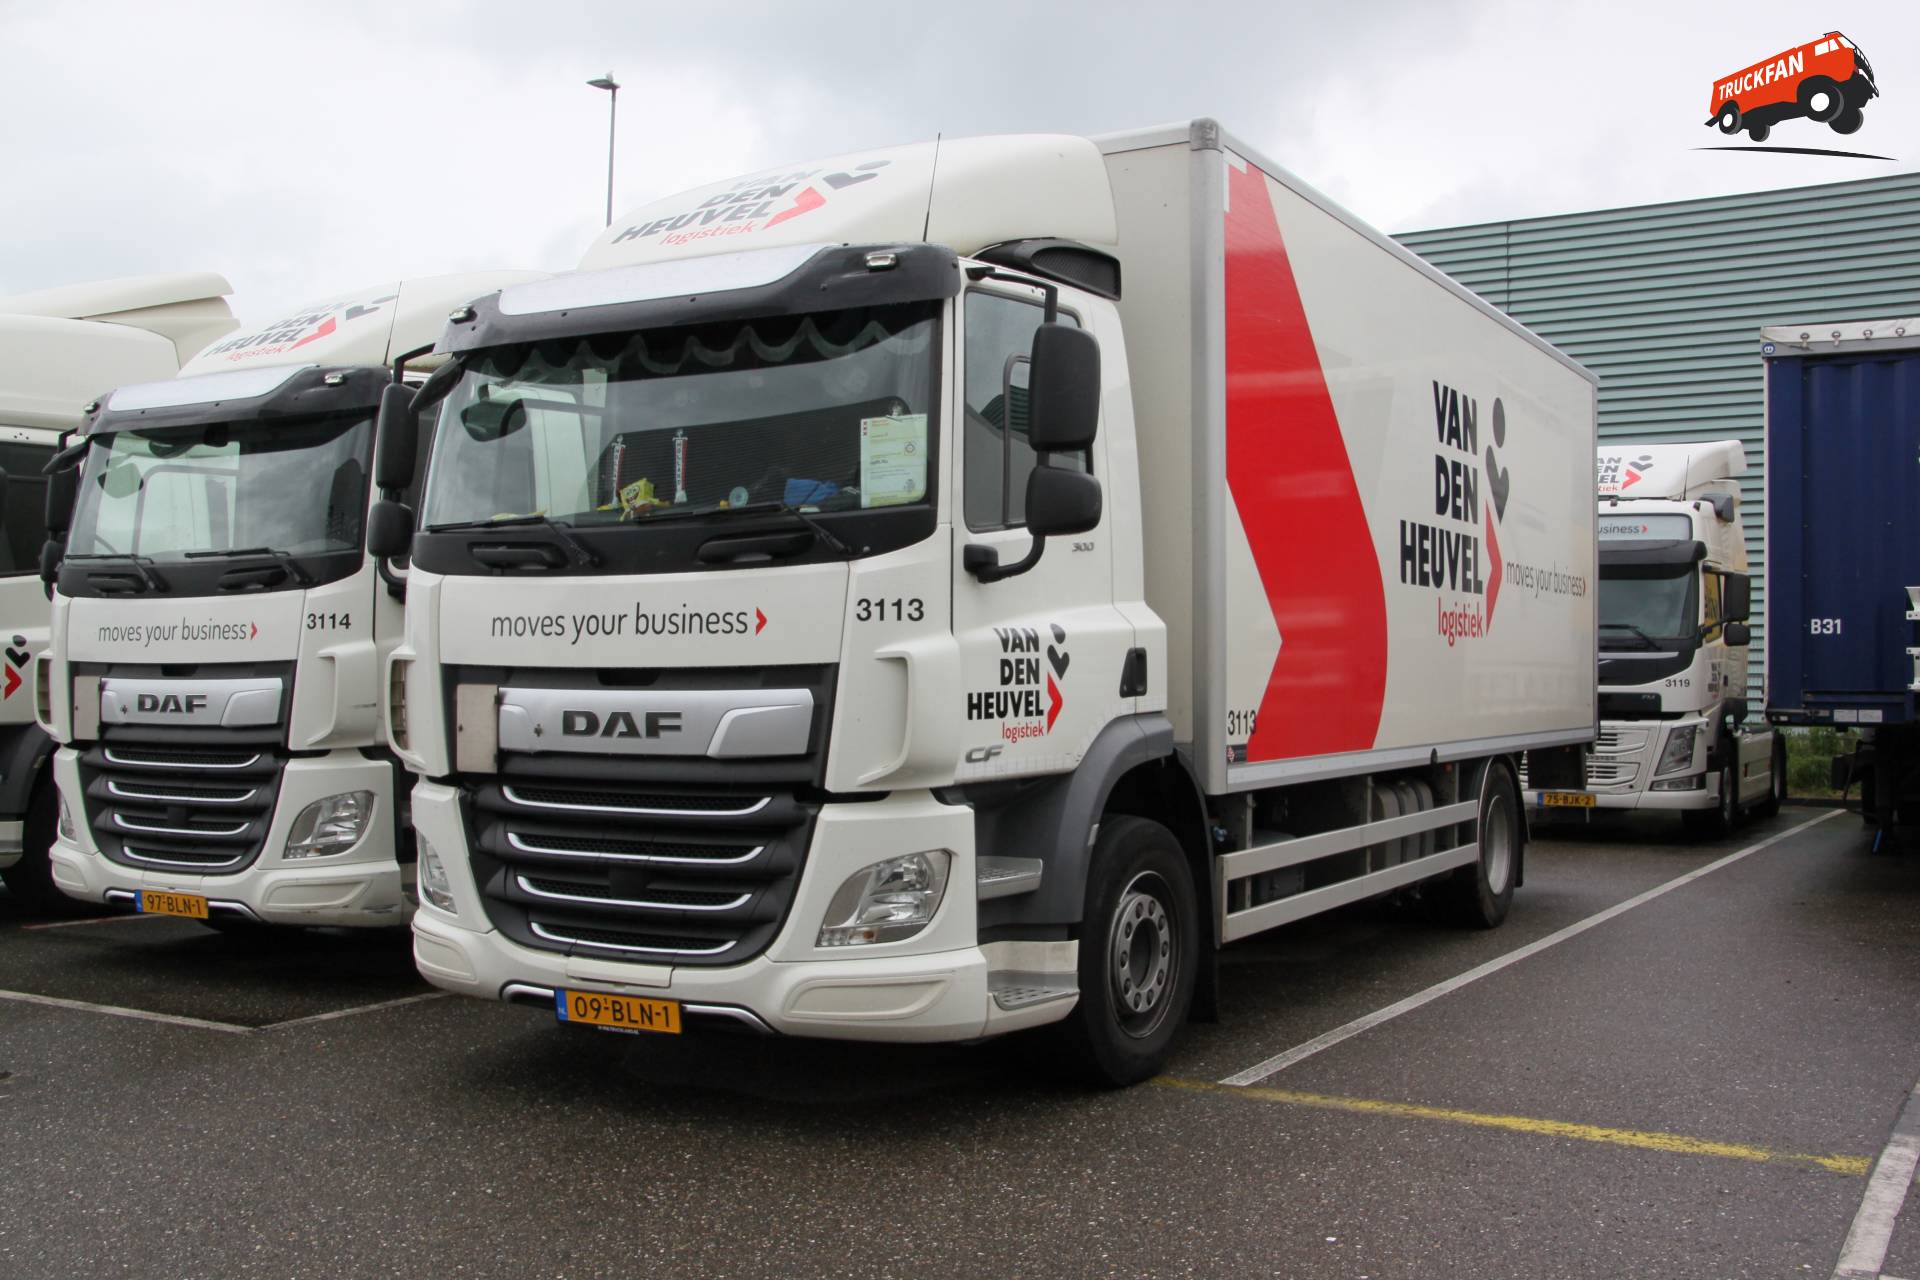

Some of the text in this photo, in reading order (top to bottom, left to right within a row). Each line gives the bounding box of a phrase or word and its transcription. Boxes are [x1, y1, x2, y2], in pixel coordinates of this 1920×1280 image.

[700, 182, 798, 209] DEN
[611, 200, 775, 245] HEUVEL
[659, 221, 757, 247] logistiek
[203, 327, 307, 358] HEUVEL
[1432, 380, 1478, 456] VAN
[1435, 453, 1478, 525] DEN
[1071, 541, 1095, 553] 300
[1399, 519, 1483, 595] HEUVEL
[1506, 561, 1582, 598] moves your business
[306, 613, 352, 630] 3114
[491, 602, 748, 645] moves your business
[855, 598, 925, 623] 3113
[1437, 597, 1483, 648] logistiek
[98, 616, 247, 647] moves your business
[993, 627, 1040, 653] VAN
[1810, 618, 1842, 635] B31
[999, 658, 1040, 686] DEN
[1665, 678, 1690, 688] 3119
[136, 693, 207, 713] DAF
[967, 690, 1044, 721] HEUVEL
[562, 710, 683, 738] DAF
[1001, 721, 1044, 744] logistiek
[1227, 709, 1257, 736] 3113
[965, 743, 1005, 764] CF
[574, 996, 670, 1028] 09-BLN-1
